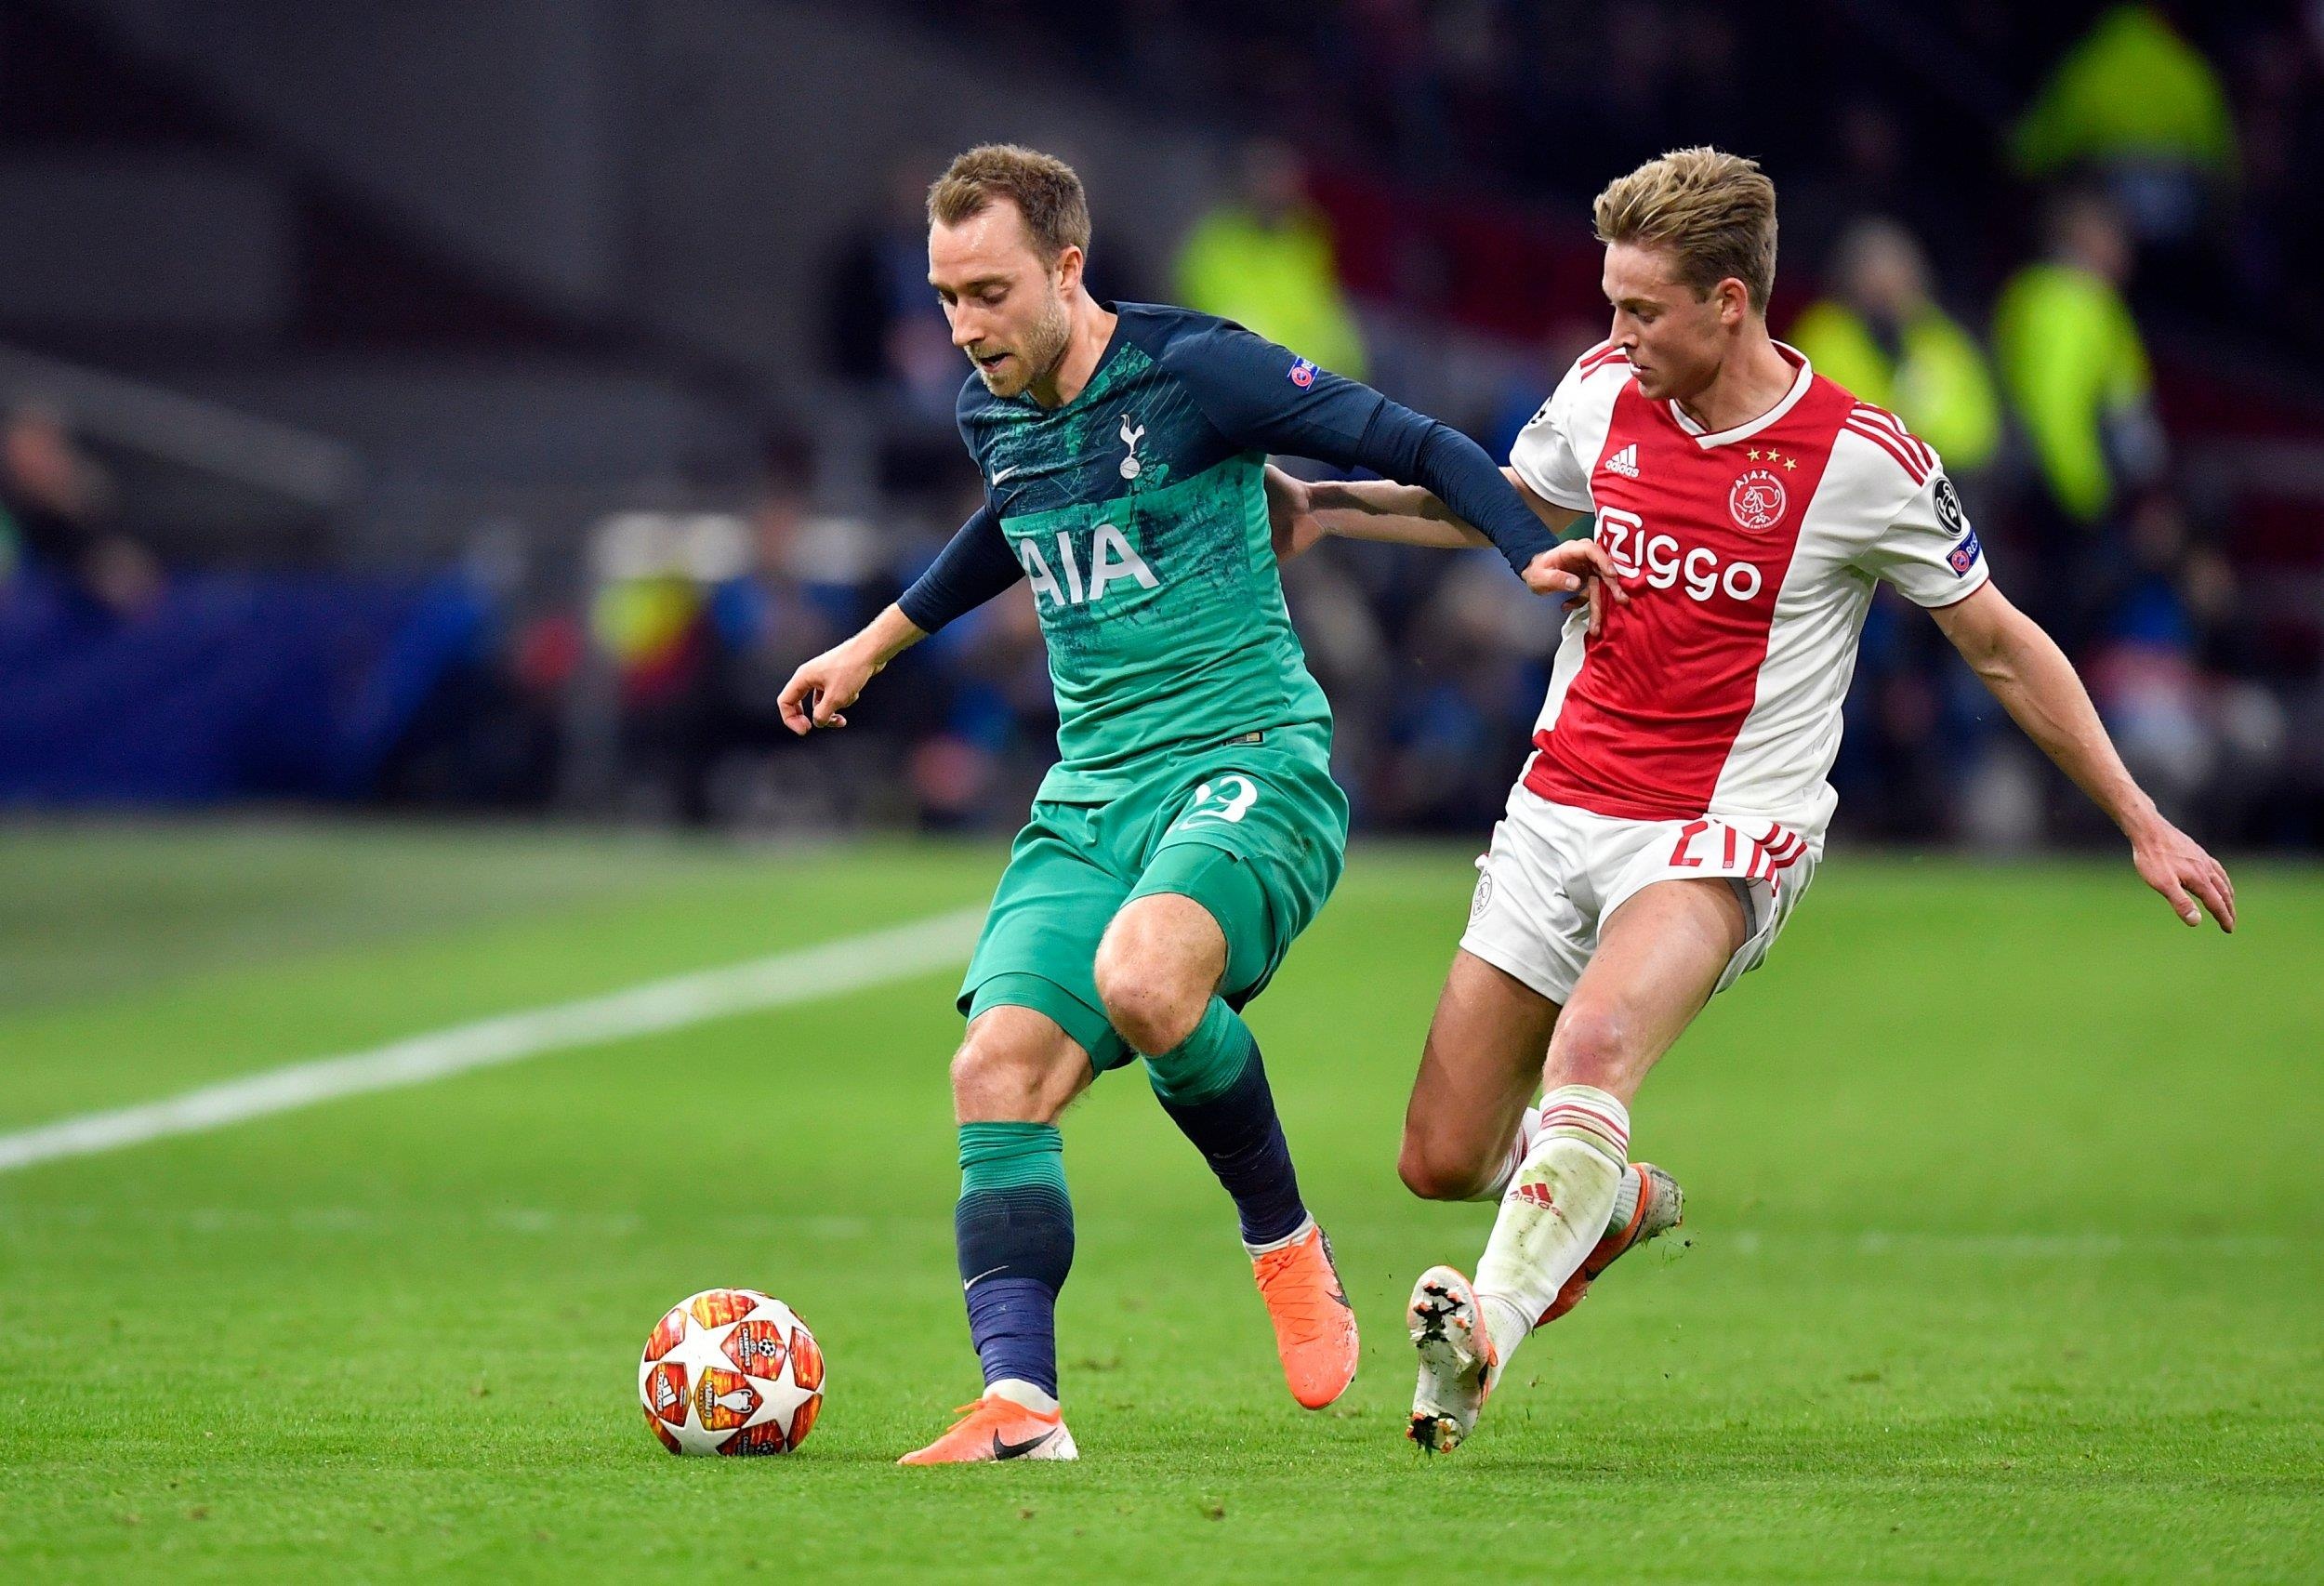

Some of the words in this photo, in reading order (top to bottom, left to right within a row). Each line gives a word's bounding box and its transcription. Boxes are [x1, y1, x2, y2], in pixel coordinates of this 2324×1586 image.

[1604, 459, 1640, 478] adidas
[1735, 469, 1768, 489] AJAX
[1020, 523, 1160, 606] AIA
[1601, 513, 1762, 601] Ziggo
[1669, 821, 1736, 869] 21
[656, 1371, 665, 1411] adidas
